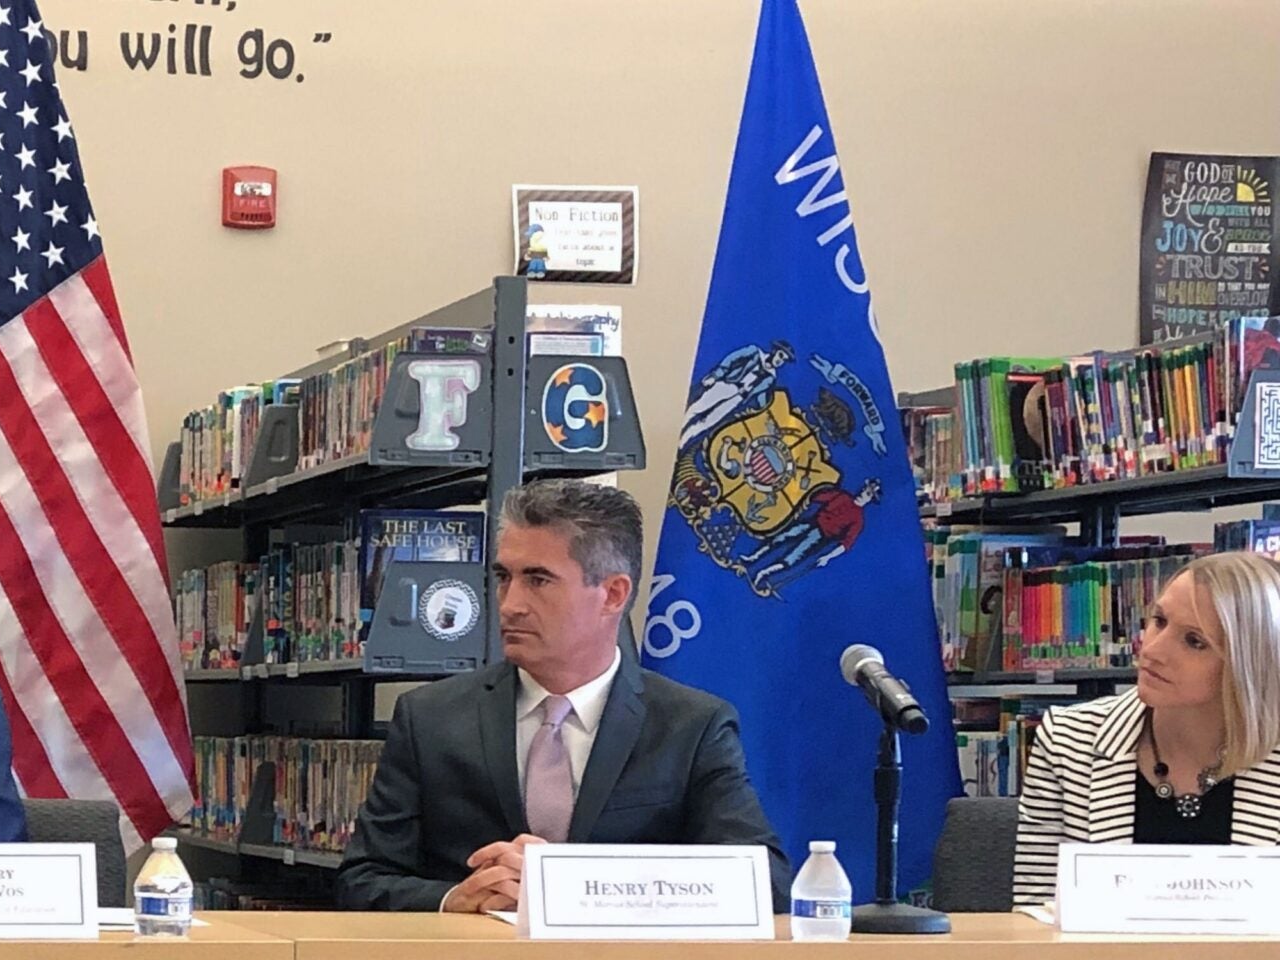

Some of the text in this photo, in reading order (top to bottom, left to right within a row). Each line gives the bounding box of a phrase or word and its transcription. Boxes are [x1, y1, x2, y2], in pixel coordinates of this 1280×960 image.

[120, 24, 212, 77] will
[1184, 161, 1220, 184] GOD
[534, 207, 619, 222] Non Fiction
[1251, 206, 1271, 216] YOU
[1155, 220, 1204, 253] JOY
[1165, 254, 1260, 280] TRUST
[1167, 307, 1207, 326] HOPE
[405, 358, 482, 451] F
[541, 362, 609, 453] G
[838, 370, 881, 427] FORWARD
[382, 520, 466, 534] THE LAST
[370, 534, 478, 549] SAFE HOUSE
